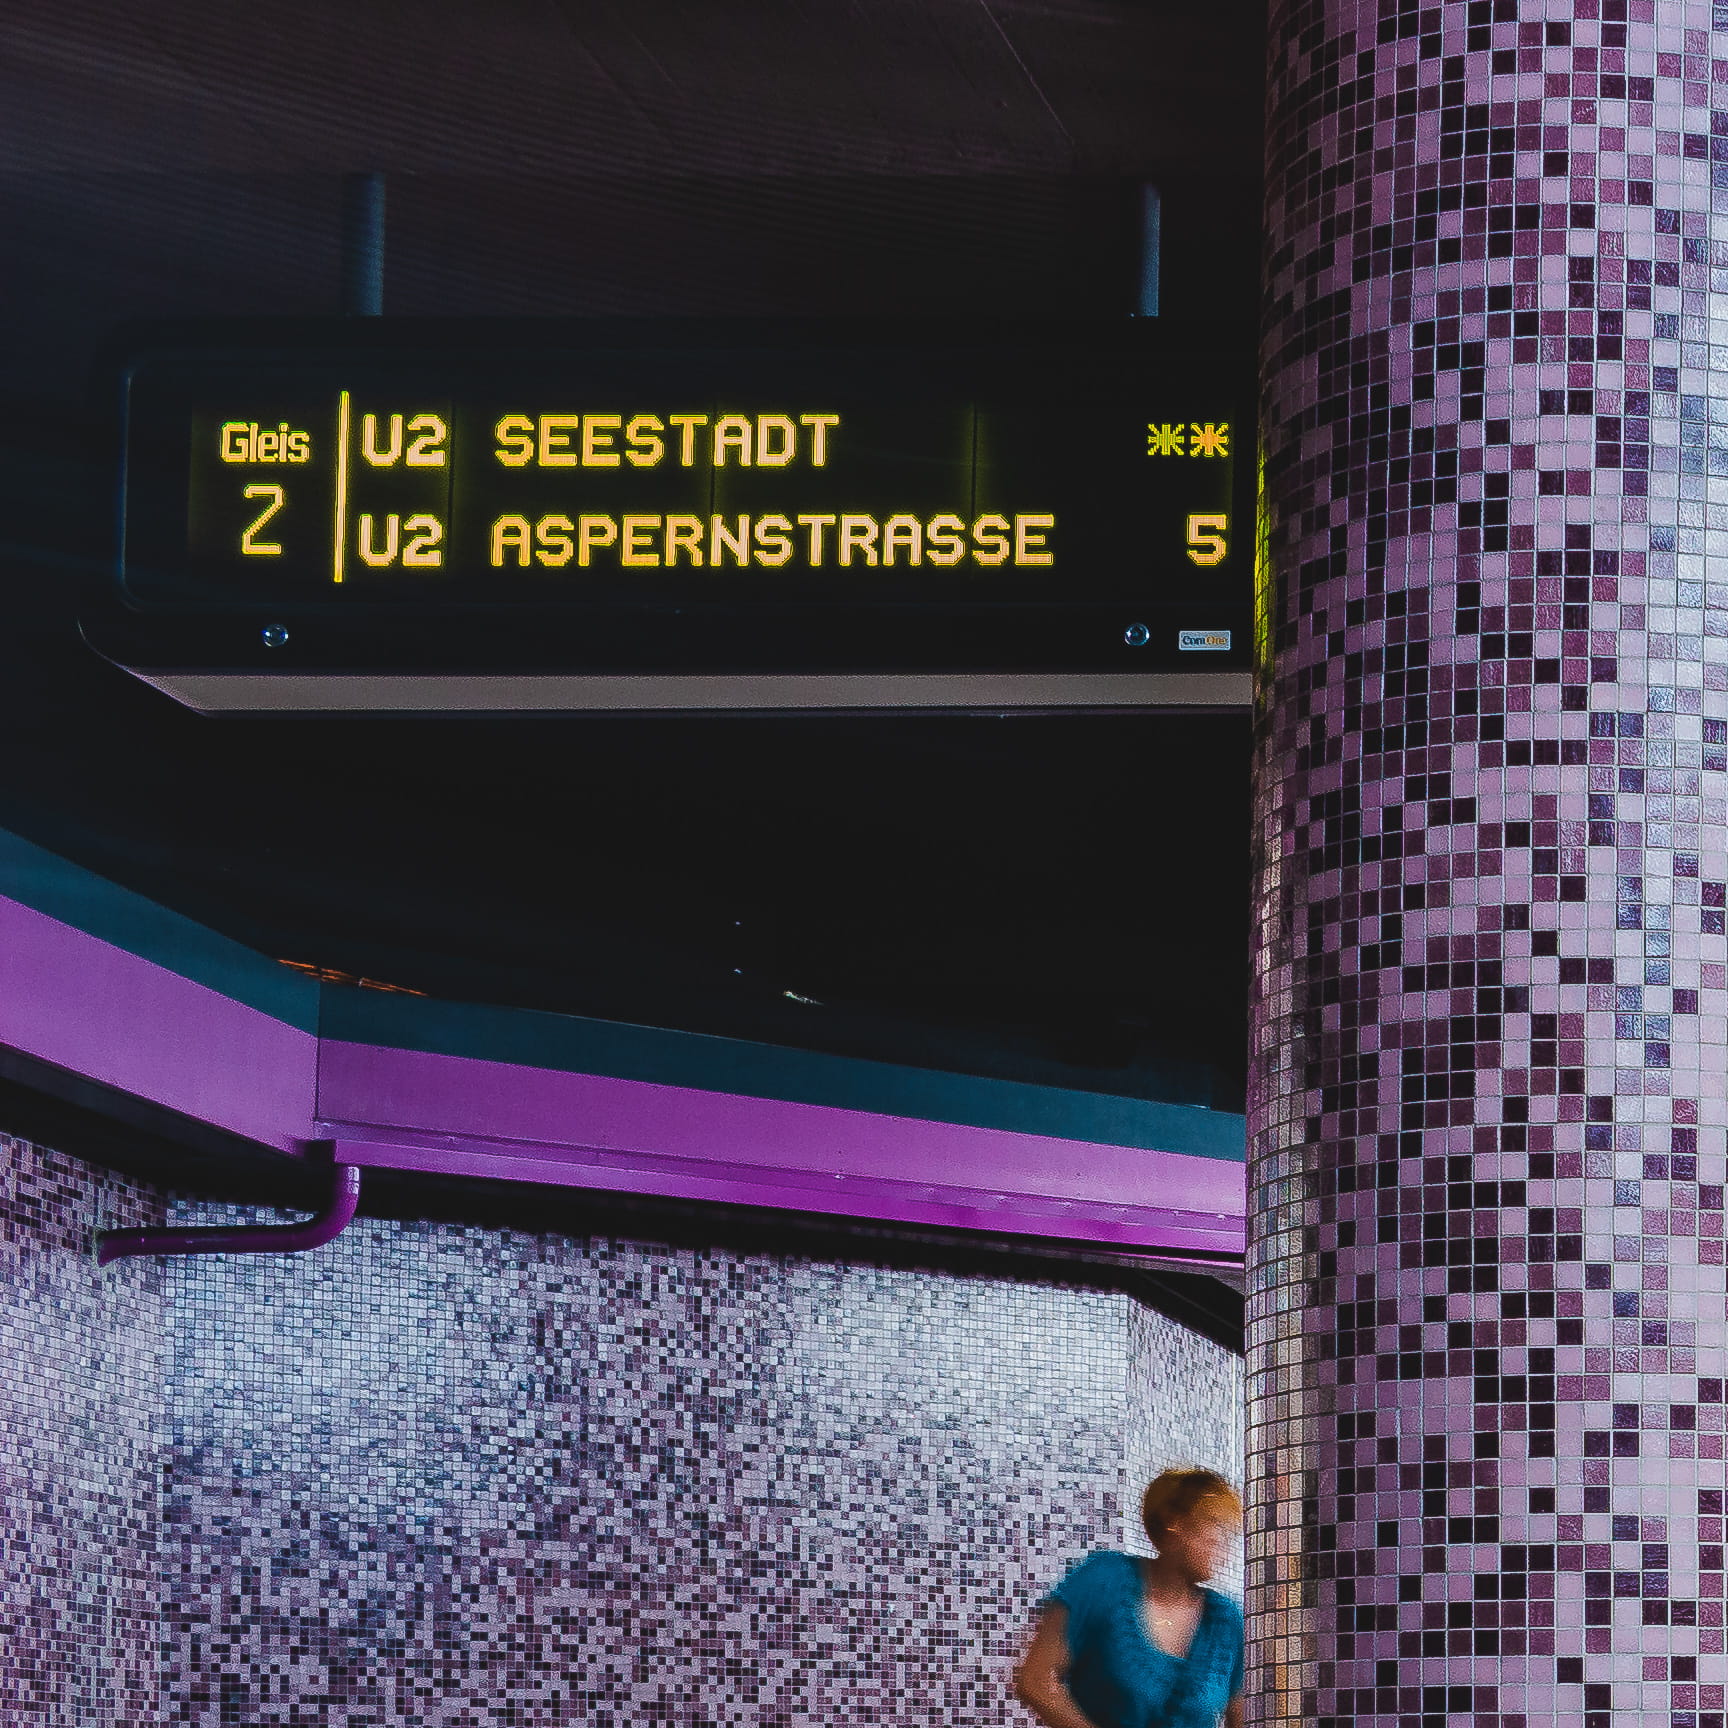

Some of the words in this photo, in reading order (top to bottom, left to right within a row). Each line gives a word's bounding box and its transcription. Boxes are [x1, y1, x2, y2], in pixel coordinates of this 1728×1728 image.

[220, 421, 311, 464] Gleis
[361, 413, 448, 468] U2
[494, 413, 840, 467] SEESTADT
[241, 483, 285, 555] 2
[358, 513, 444, 568] U2
[490, 512, 1055, 567] ASPERNSTRASSE
[1186, 513, 1229, 566] 5
